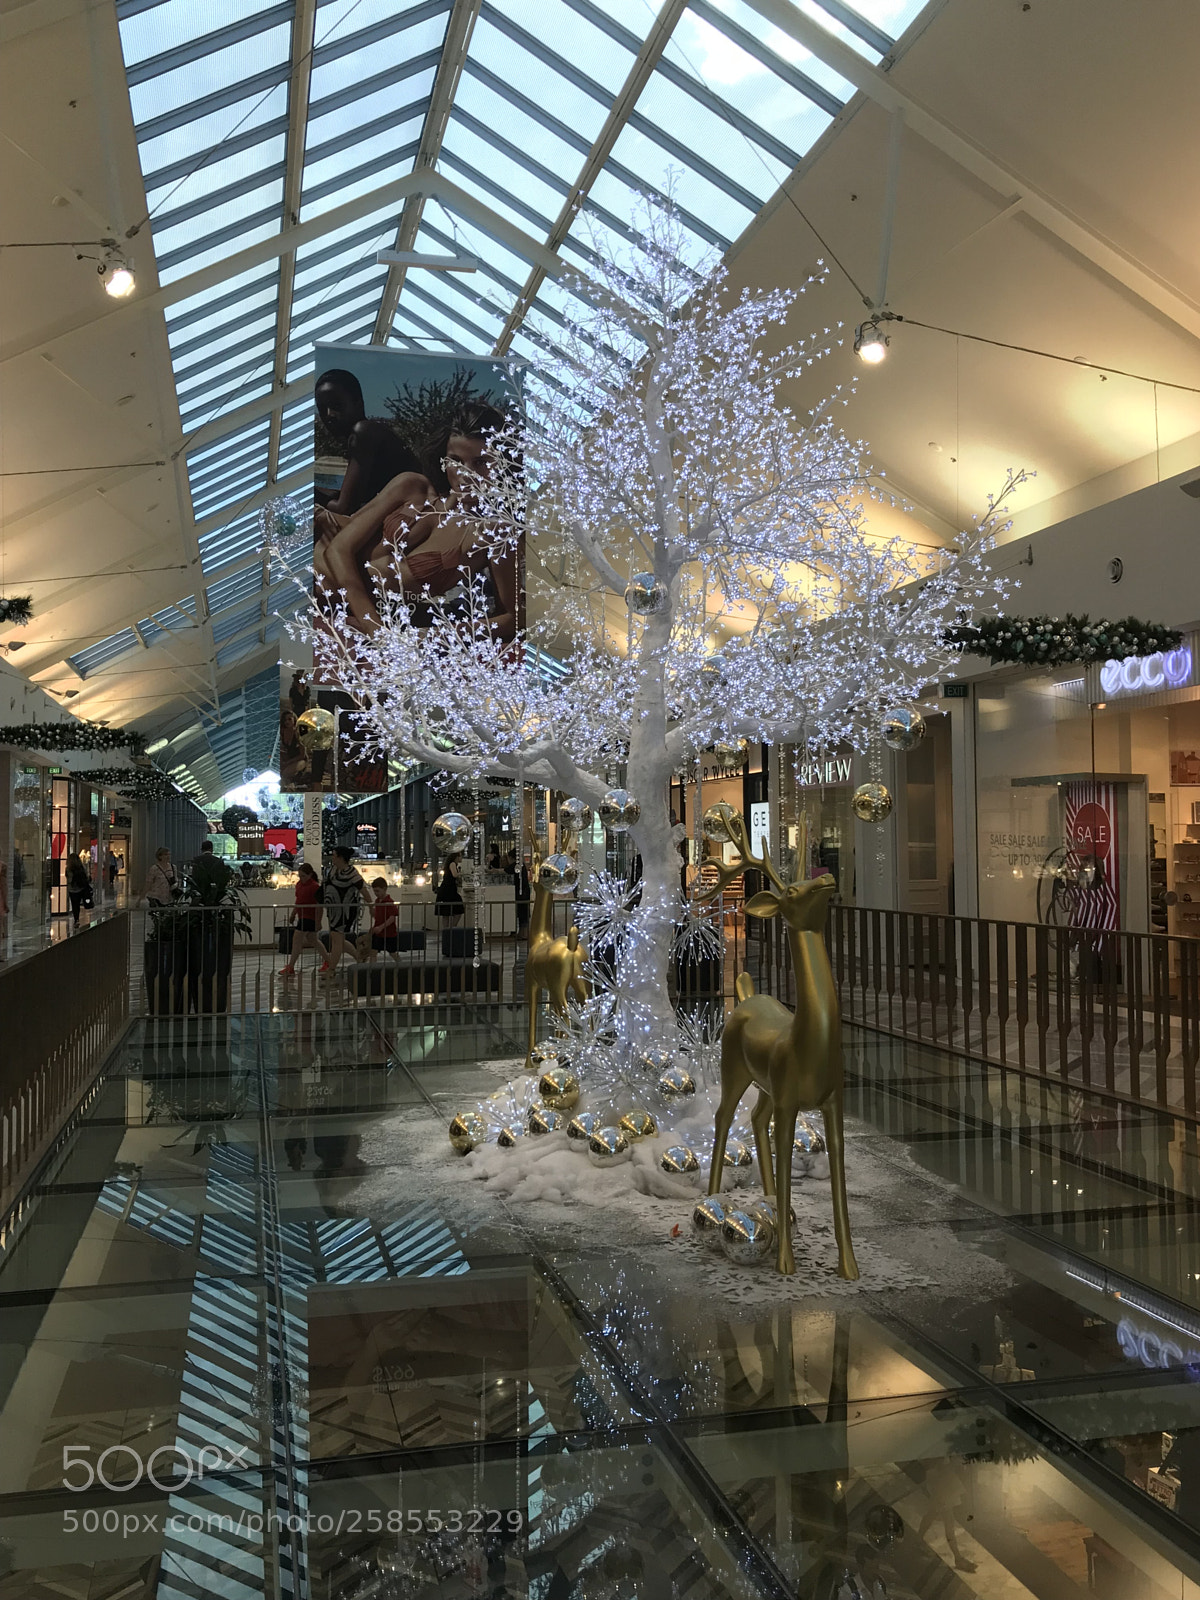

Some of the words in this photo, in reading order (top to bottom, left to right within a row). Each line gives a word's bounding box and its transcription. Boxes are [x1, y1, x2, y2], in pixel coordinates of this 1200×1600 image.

[405, 590, 424, 603] Top
[1100, 650, 1191, 693] ecco
[947, 686, 964, 696] EXIT
[686, 767, 709, 782] OSCR
[800, 758, 852, 785] REVIEW
[311, 797, 320, 846] GODDESS
[753, 811, 769, 827] GE
[990, 834, 1007, 846] SALE
[1008, 834, 1026, 846] SALE
[1008, 854, 1018, 866] UP
[1020, 854, 1030, 866] TO
